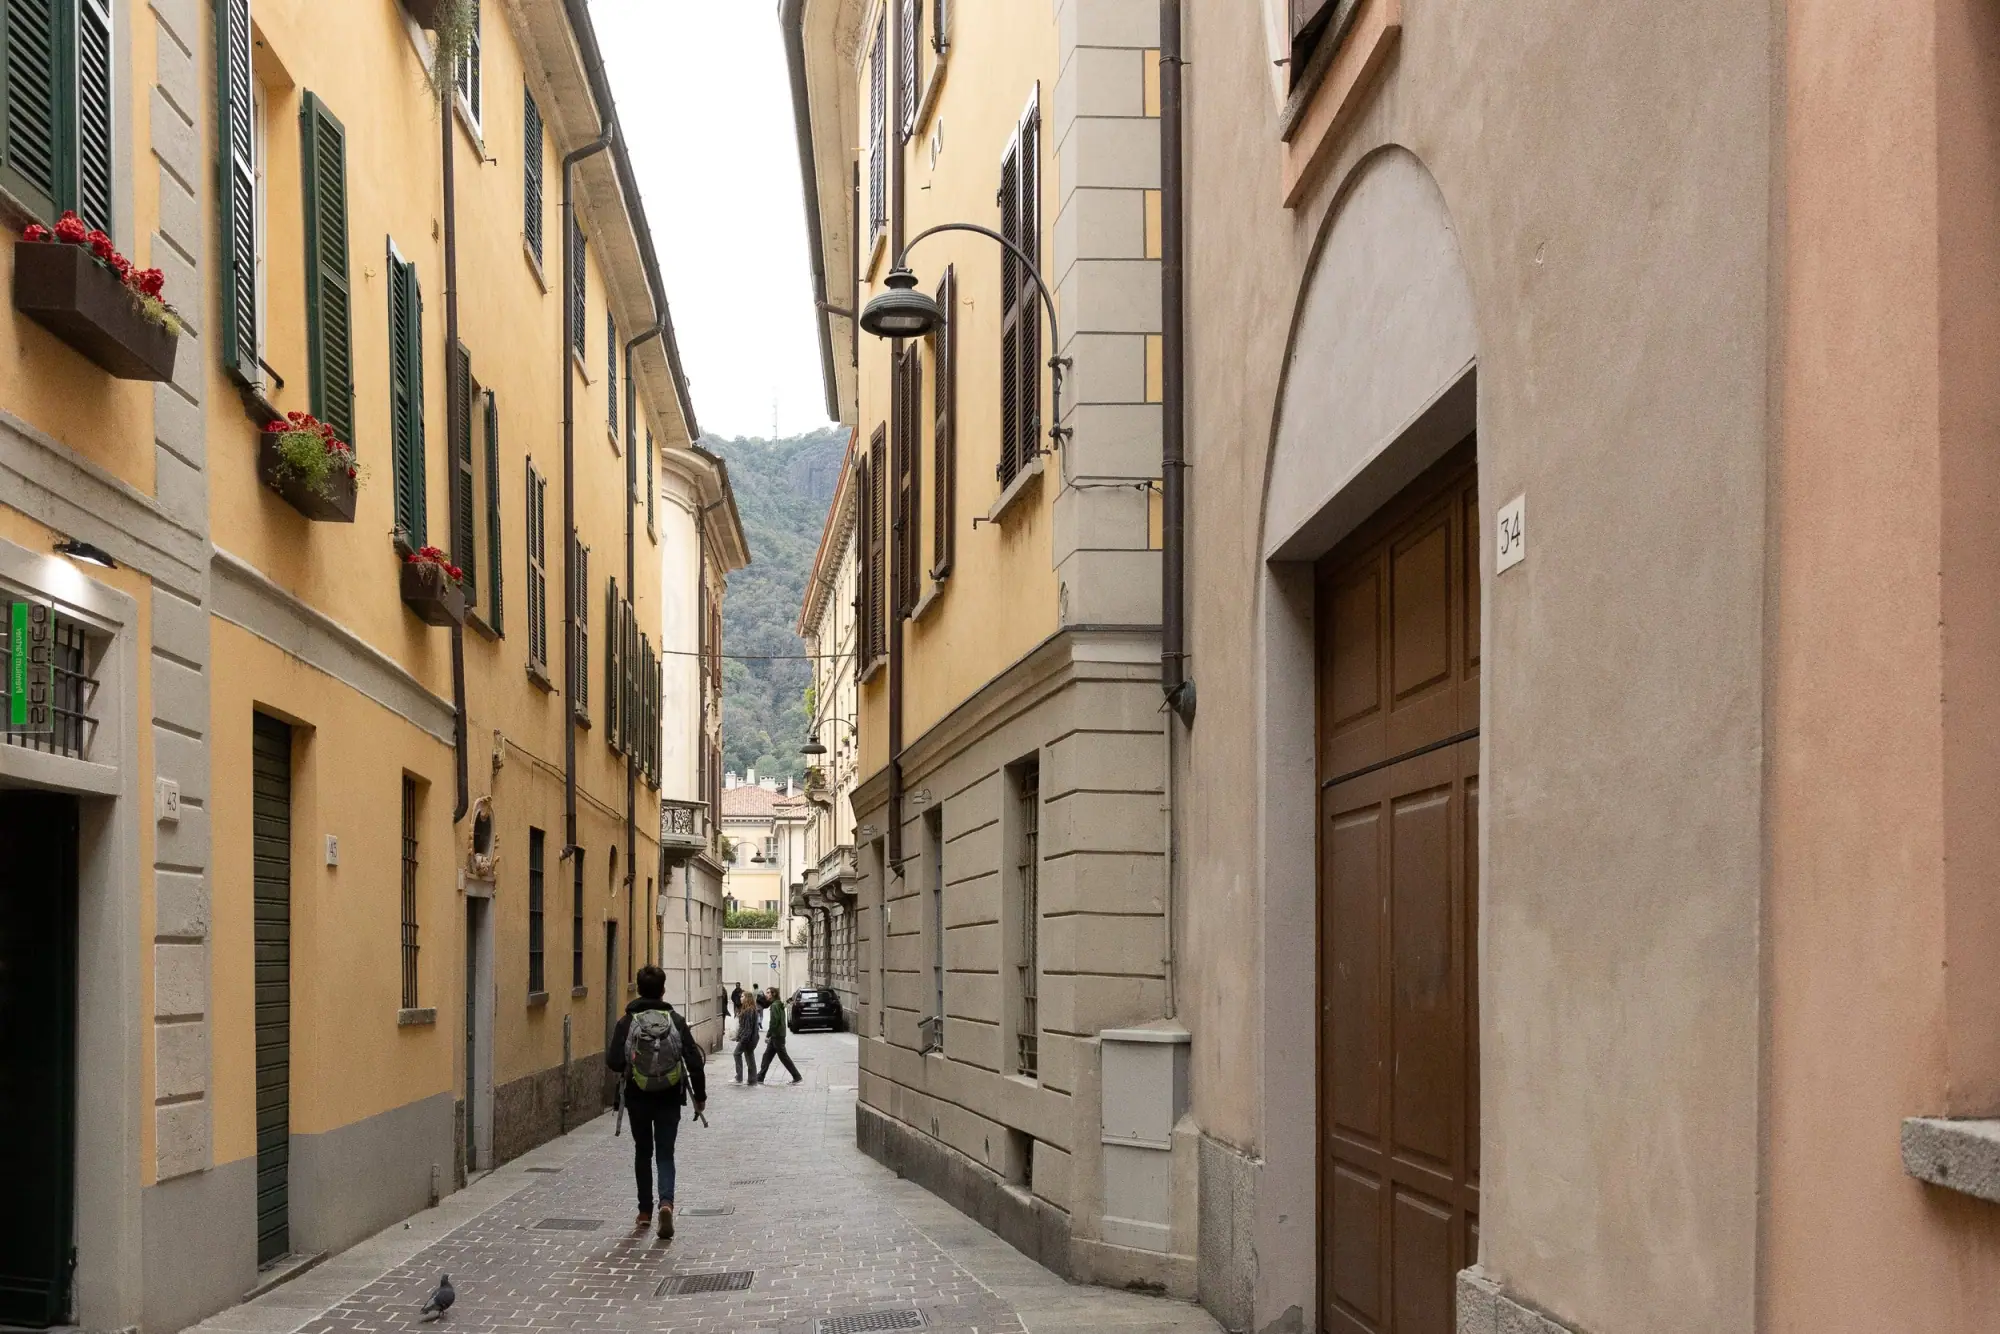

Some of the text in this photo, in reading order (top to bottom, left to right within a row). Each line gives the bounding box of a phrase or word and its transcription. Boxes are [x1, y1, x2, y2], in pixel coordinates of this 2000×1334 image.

[1501, 510, 1520, 554] 34
[167, 791, 177, 812] 43
[328, 840, 337, 858] 45
